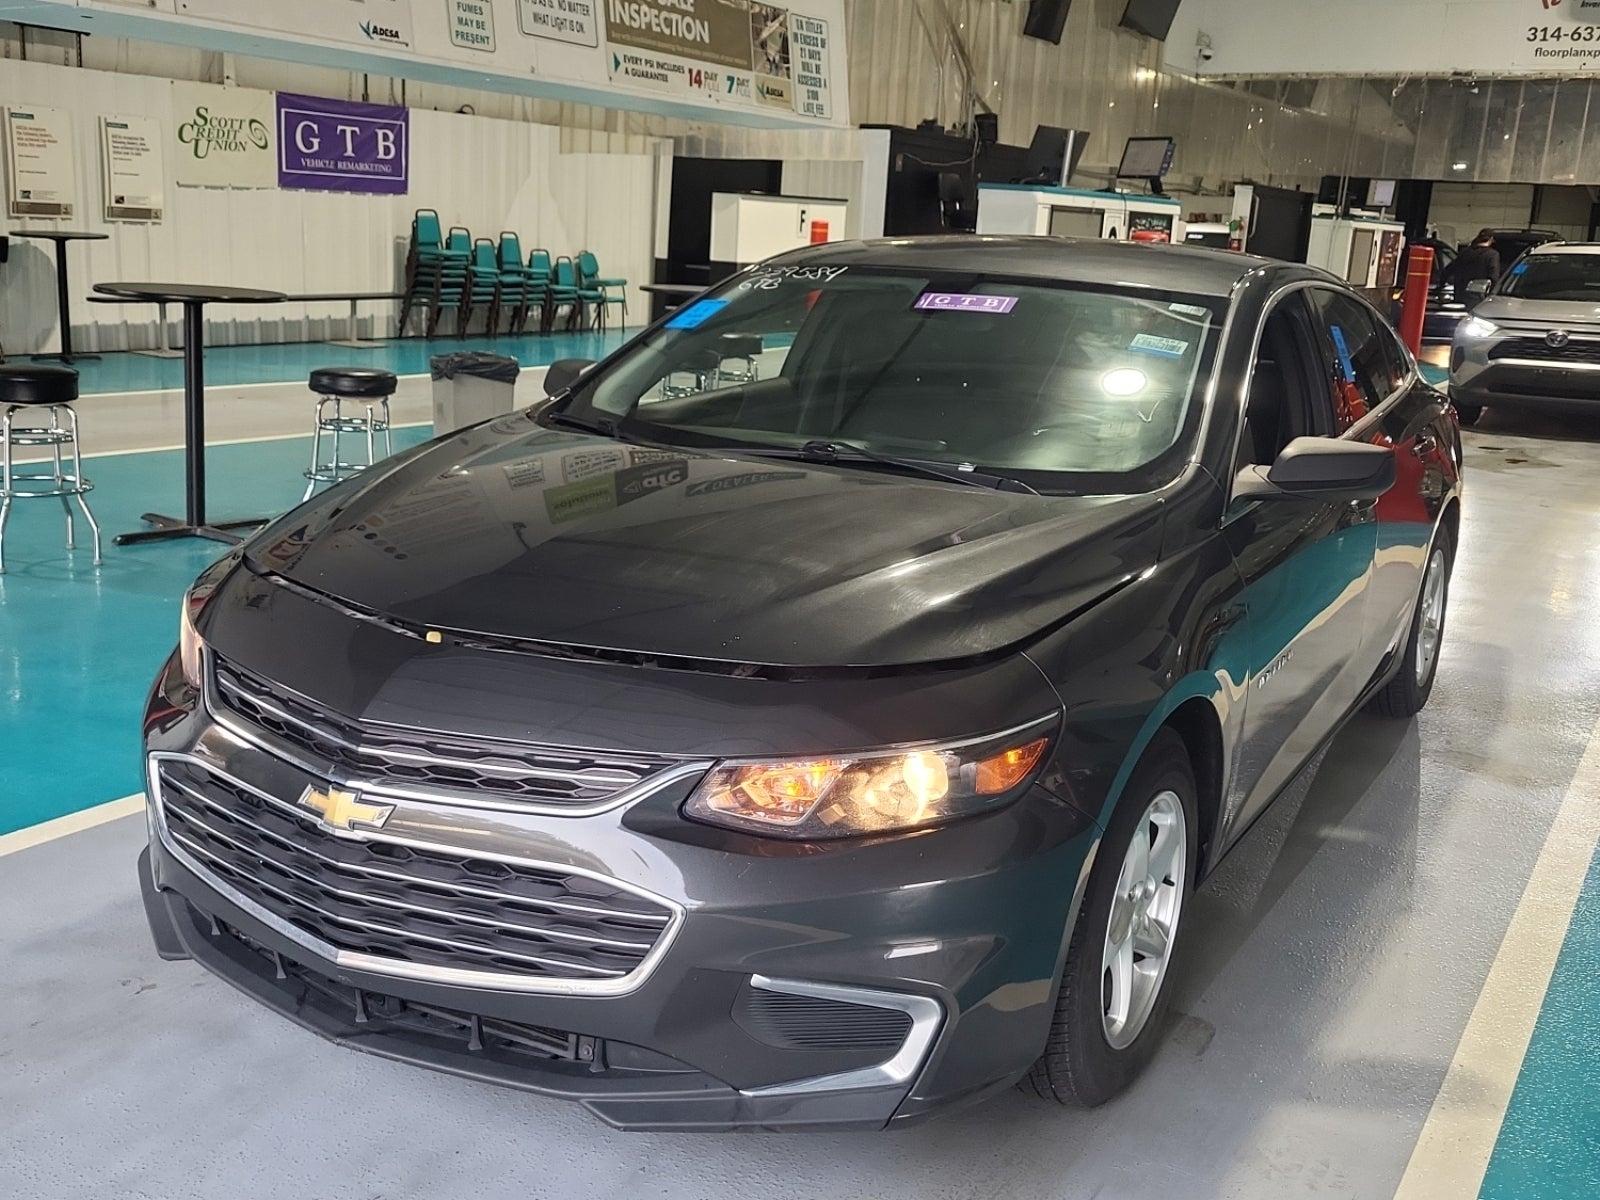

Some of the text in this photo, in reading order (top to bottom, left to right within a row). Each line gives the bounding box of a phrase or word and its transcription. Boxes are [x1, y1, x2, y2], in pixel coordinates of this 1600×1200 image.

[457, 2, 483, 15] FUMES
[568, 1, 590, 16] MATTER
[457, 16, 486, 30] MAY BE
[533, 12, 549, 26] WHAT
[551, 15, 567, 31] LIGHT
[609, 0, 710, 44] INSPECTION
[372, 25, 400, 39] ADESA
[455, 30, 490, 45] PRESENT
[623, 54, 643, 66] EVERY
[656, 61, 685, 74] INCLUDES
[631, 68, 669, 82] GUARANTEE
[688, 68, 719, 88] 14 DAY
[727, 75, 735, 94] 7
[193, 106, 246, 129] SCOTT
[178, 123, 240, 143] CREDIT
[194, 138, 247, 159] UNION
[301, 158, 392, 173] VEHICLE REMARKETING
